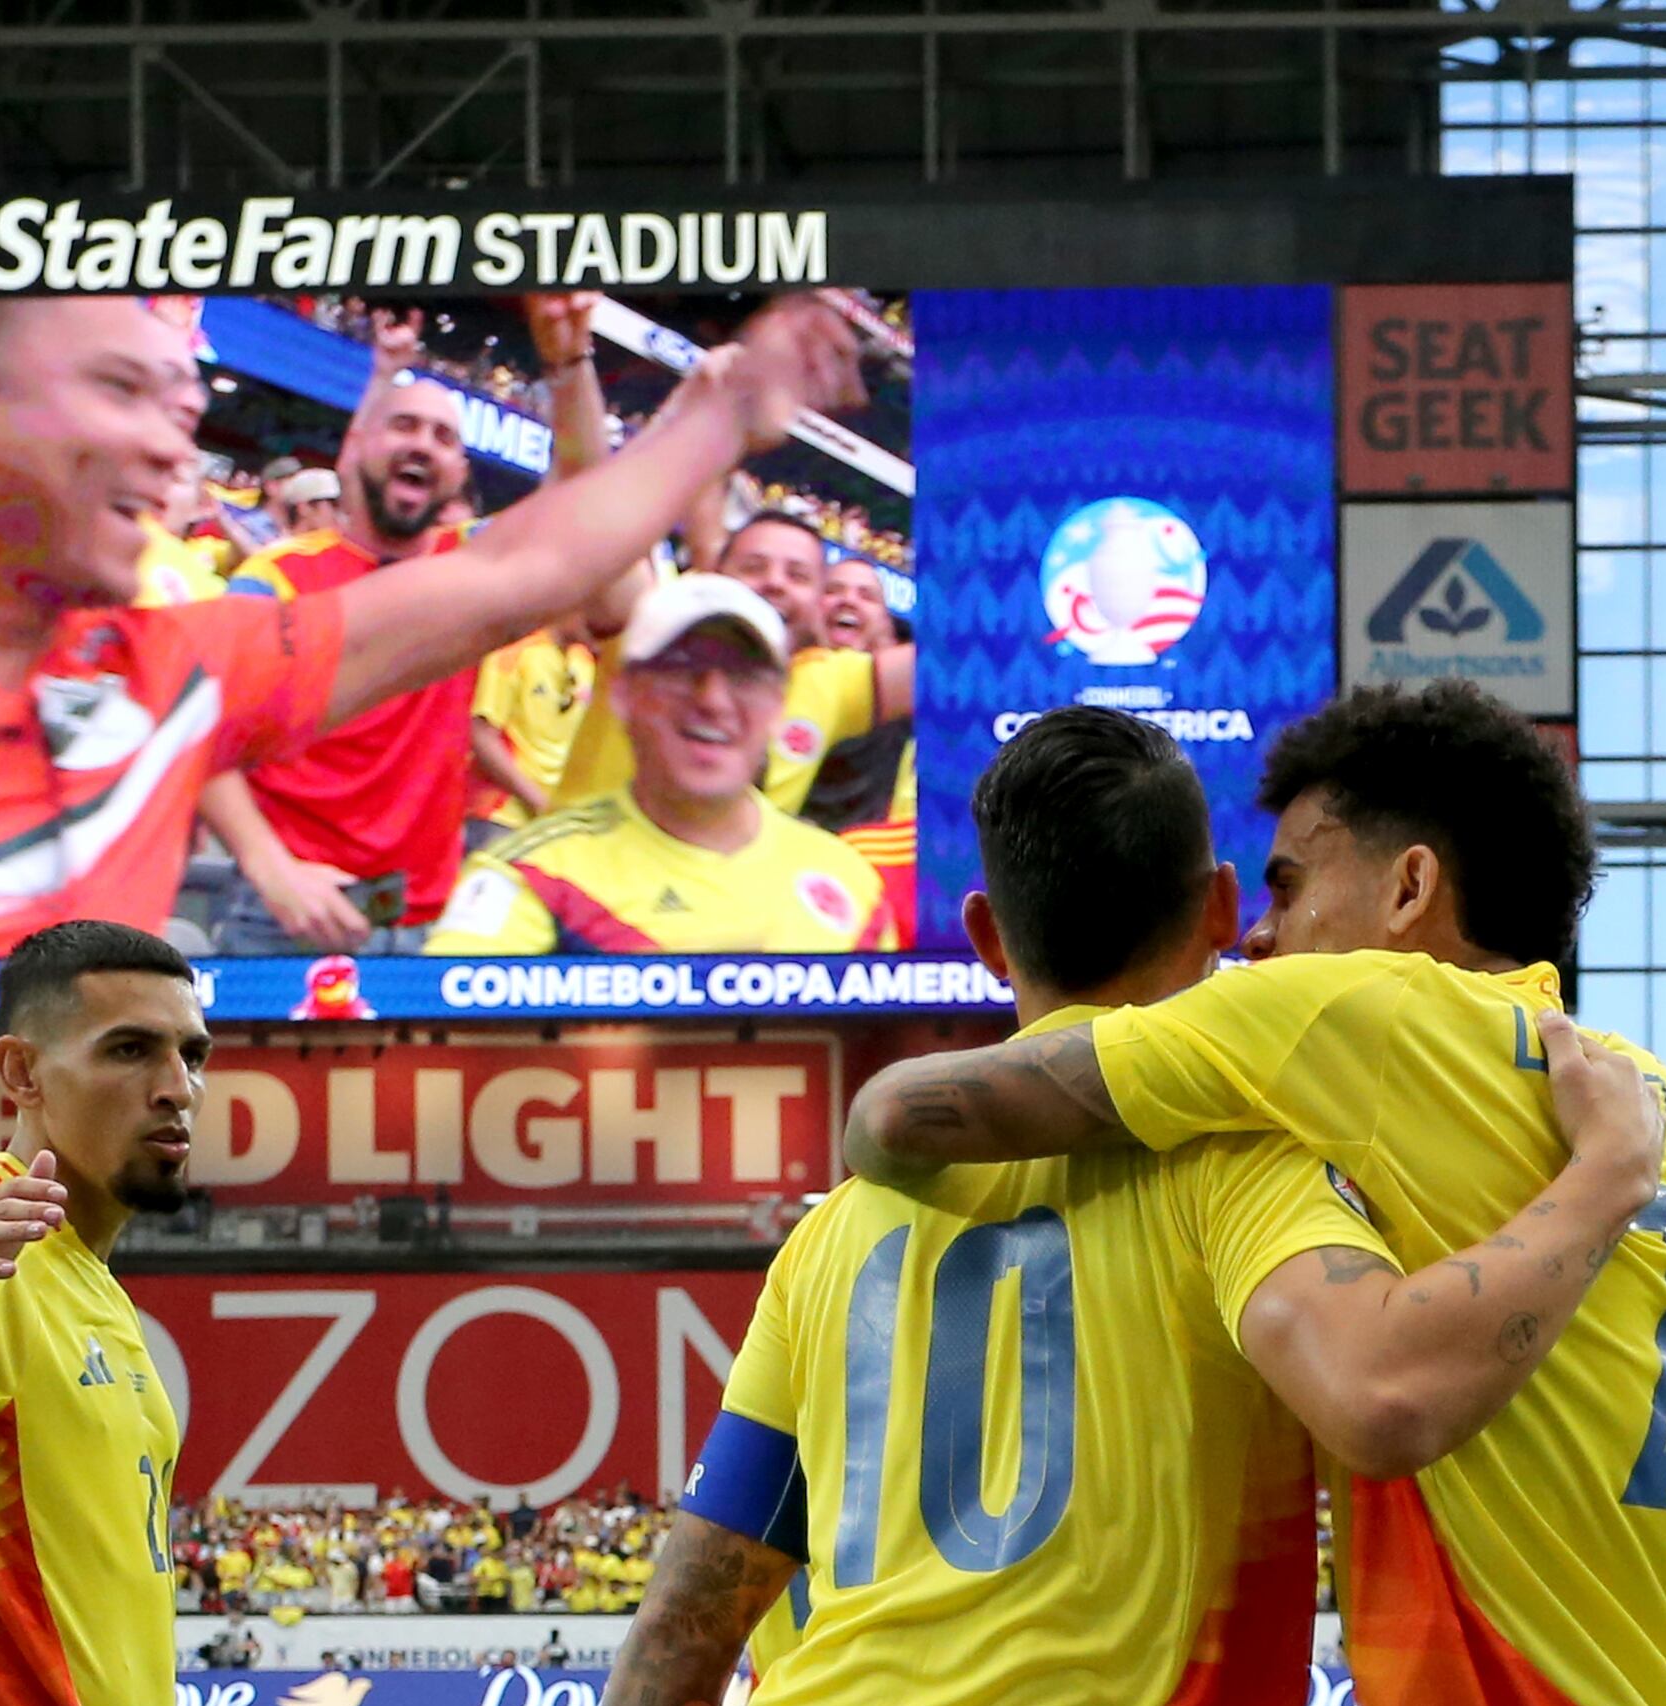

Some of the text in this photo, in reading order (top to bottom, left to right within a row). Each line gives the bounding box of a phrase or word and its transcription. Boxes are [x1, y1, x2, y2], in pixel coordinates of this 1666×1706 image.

[472, 211, 829, 286] STADIUM
[1370, 317, 1543, 382] SEAT
[1360, 386, 1551, 452] GEEK
[1369, 650, 1546, 677] Albertsons
[441, 961, 1015, 1009] CONMEBOL COPA AMERIC
[328, 1066, 807, 1187] LIGHT
[834, 1204, 1077, 1589] 10
